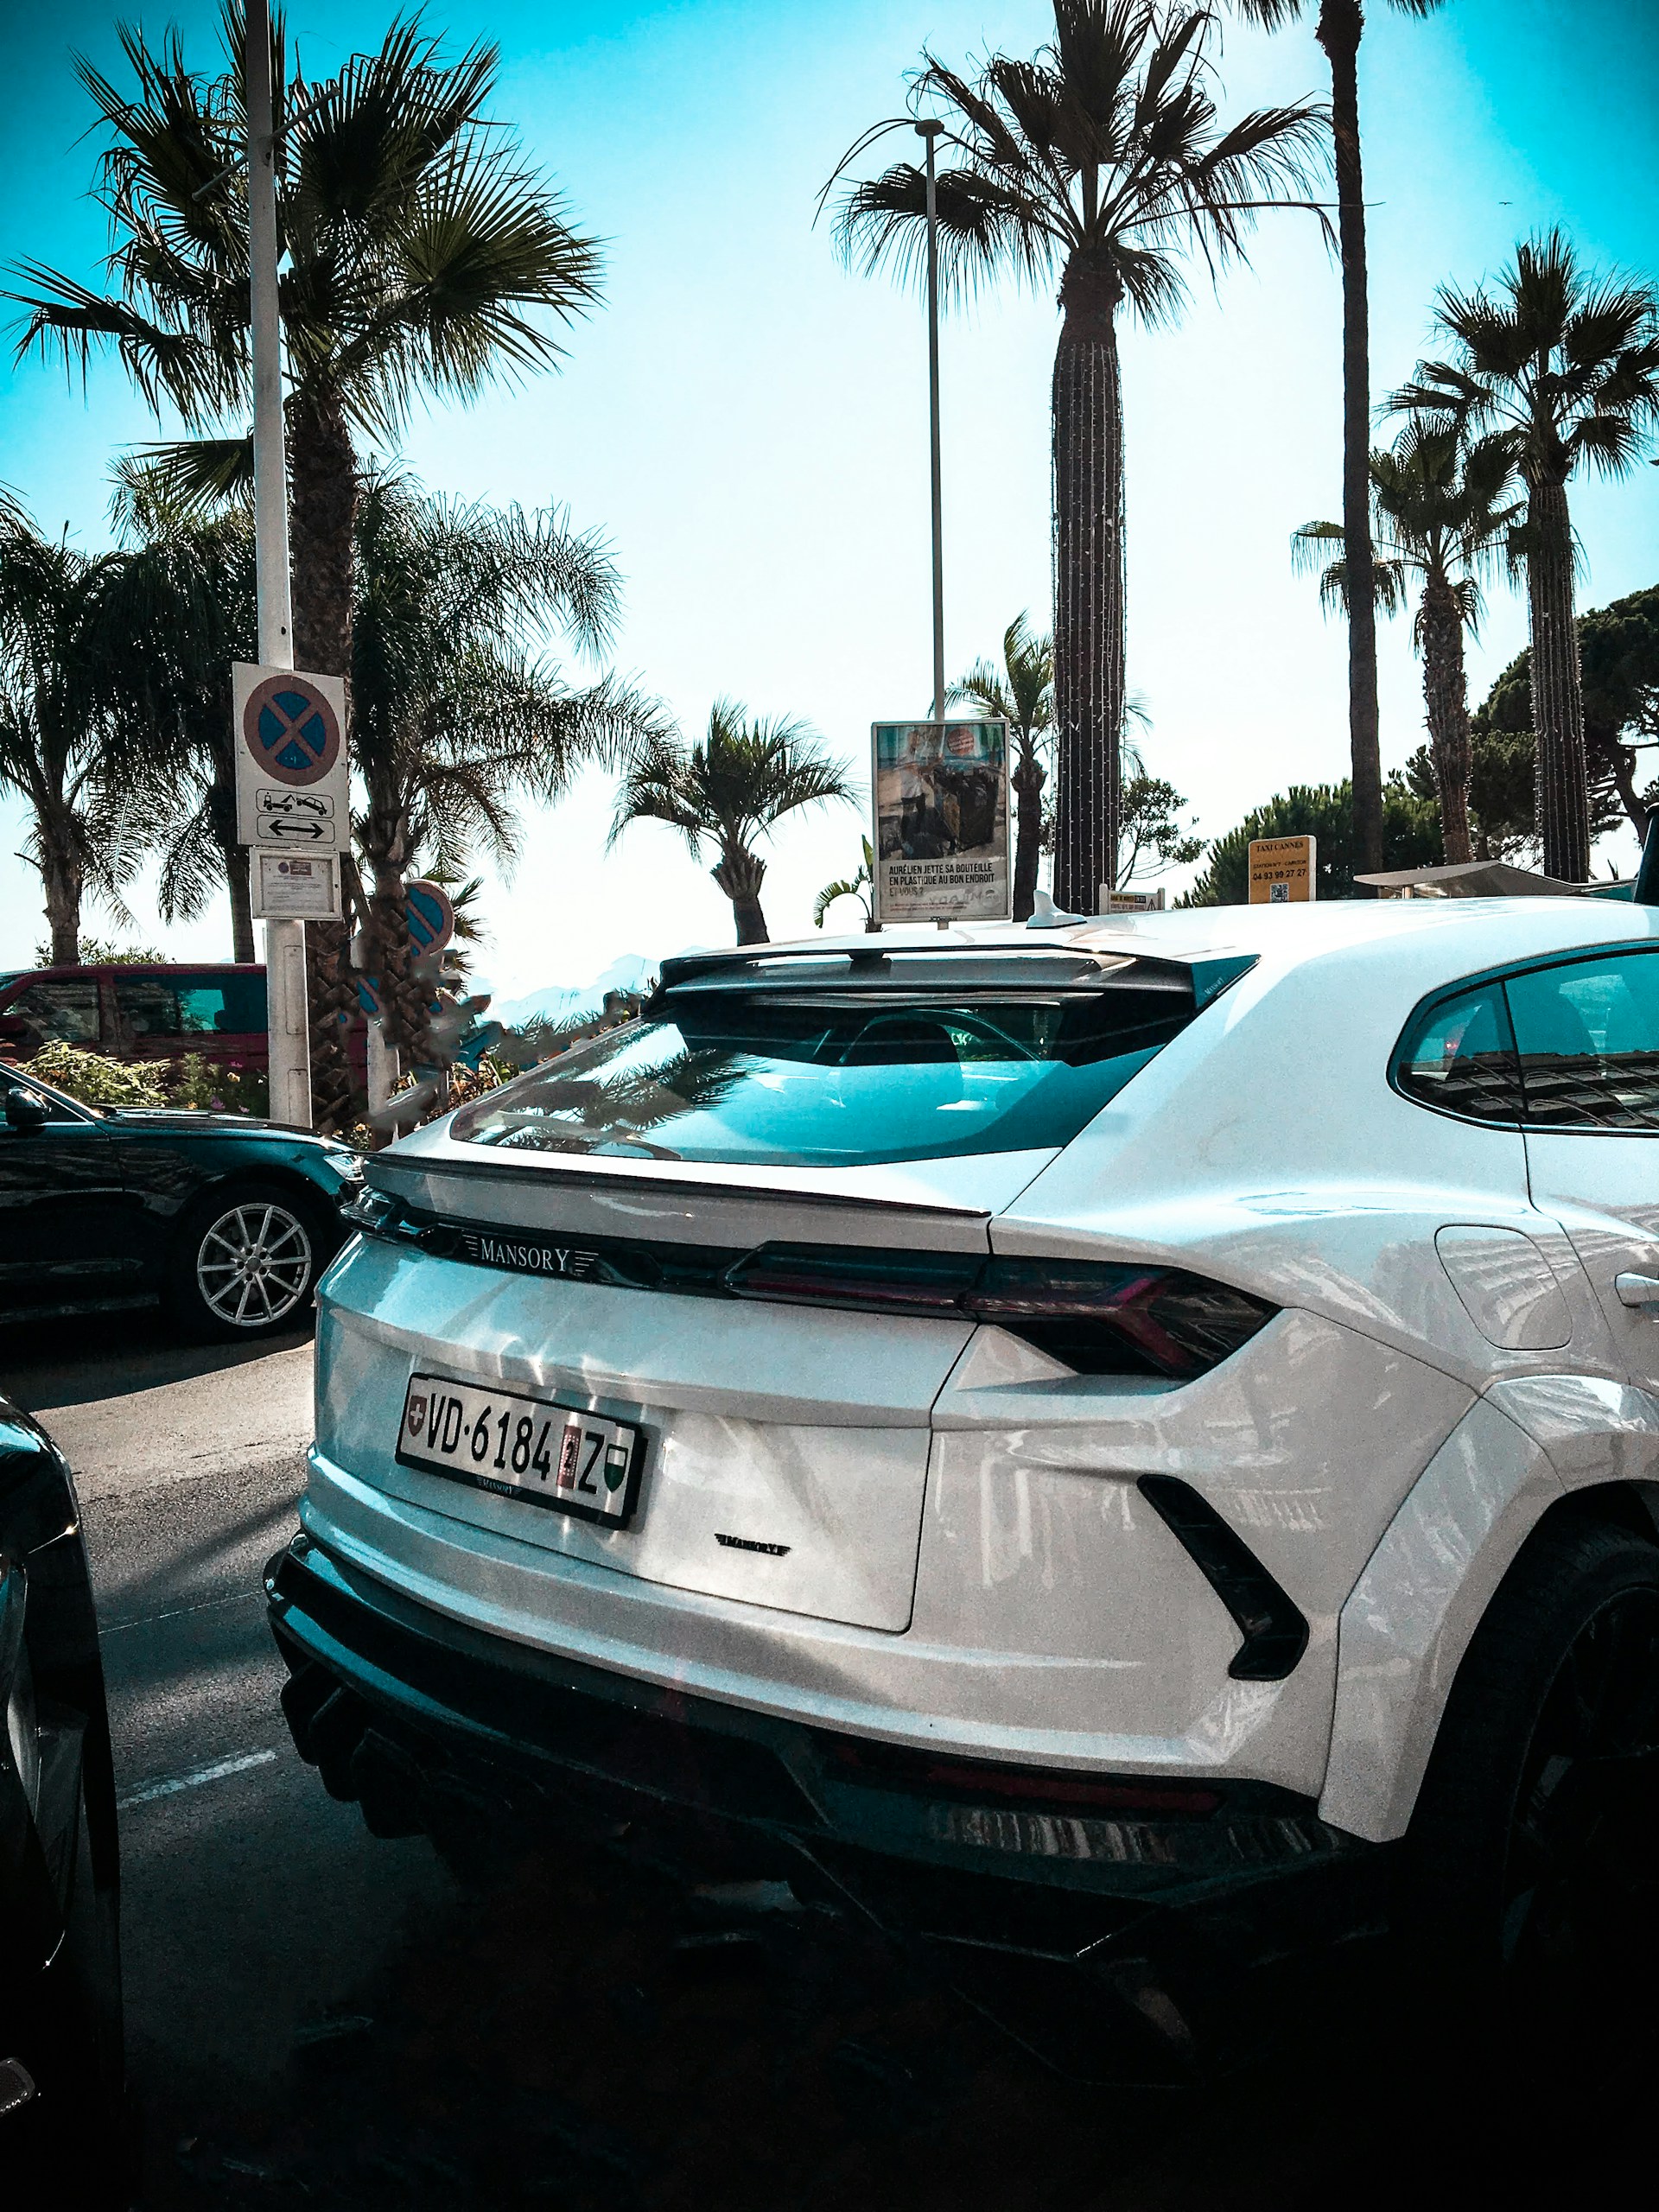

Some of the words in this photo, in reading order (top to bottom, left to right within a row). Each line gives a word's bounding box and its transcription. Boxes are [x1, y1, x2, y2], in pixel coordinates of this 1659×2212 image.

[889, 864, 922, 874] AURÉLIEN
[923, 864, 943, 874] JETTE
[945, 864, 954, 874] SA
[957, 863, 993, 873] BOUTEILLE
[889, 876, 899, 886] EN
[900, 875, 937, 885] PLASTIQUE
[938, 875, 948, 884] AU
[950, 874, 963, 884] BON
[966, 874, 995, 883] ENDROIT
[889, 887, 898, 897] ET
[899, 887, 918, 896] VOUS
[480, 1238, 570, 1272] MANSORY
[578, 1431, 605, 1495] Z
